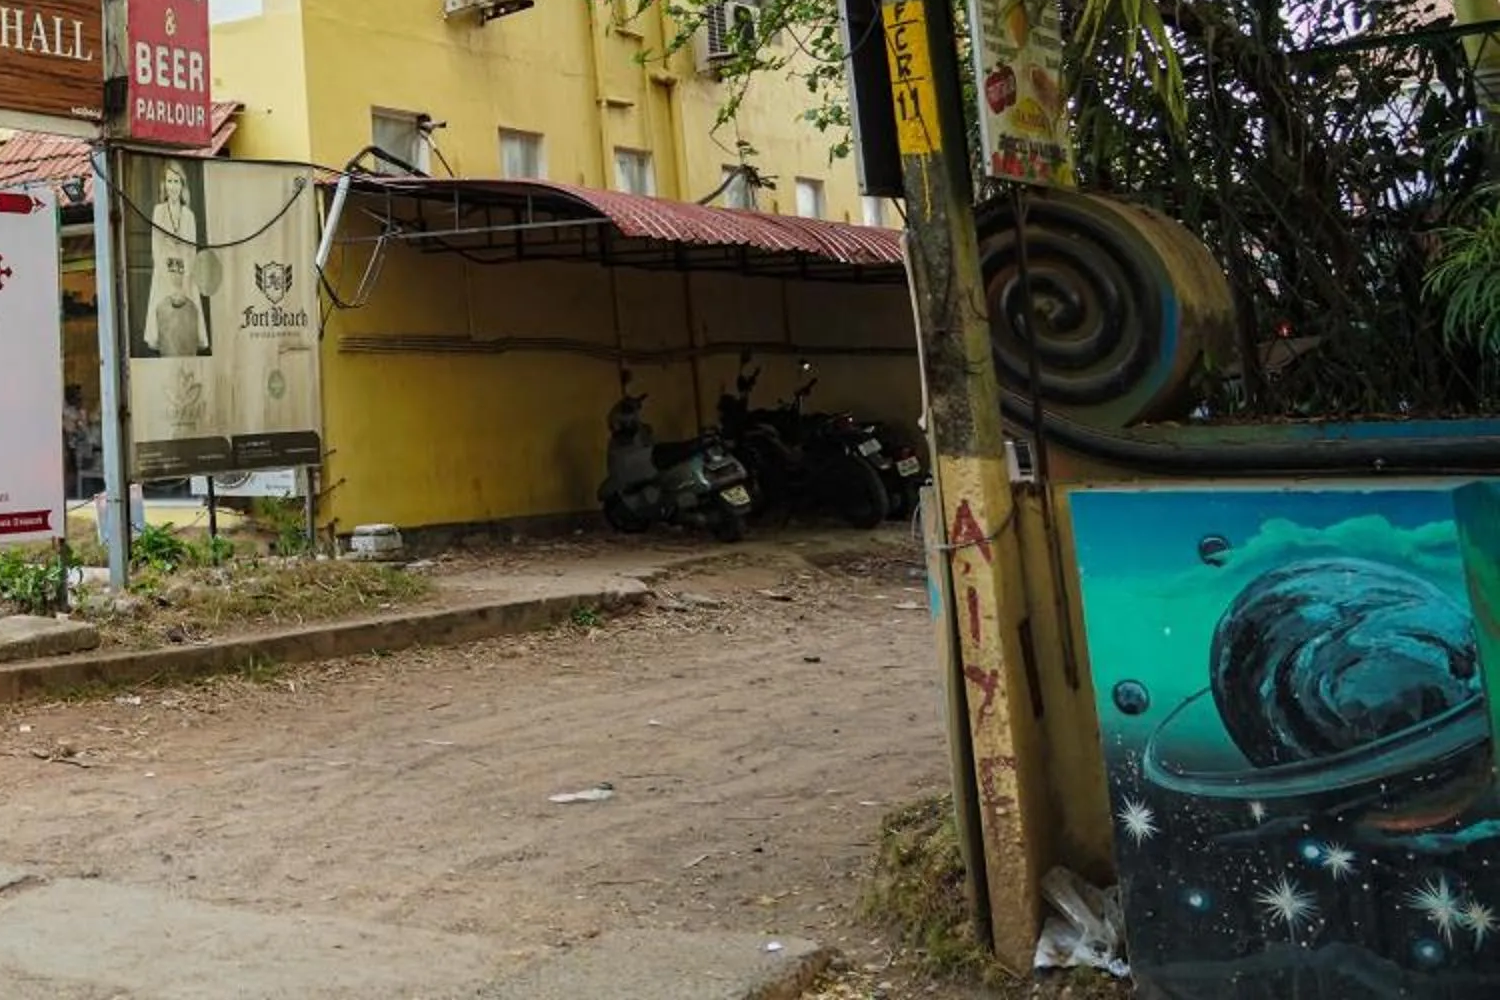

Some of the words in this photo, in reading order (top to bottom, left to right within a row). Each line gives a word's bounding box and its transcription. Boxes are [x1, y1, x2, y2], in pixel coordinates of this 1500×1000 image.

[0, 5, 93, 61] HALL
[164, 7, 177, 36] &
[135, 40, 205, 93] BEER
[136, 97, 205, 127] PARLOUR
[240, 305, 269, 329] Fort
[270, 305, 309, 327] Beach
